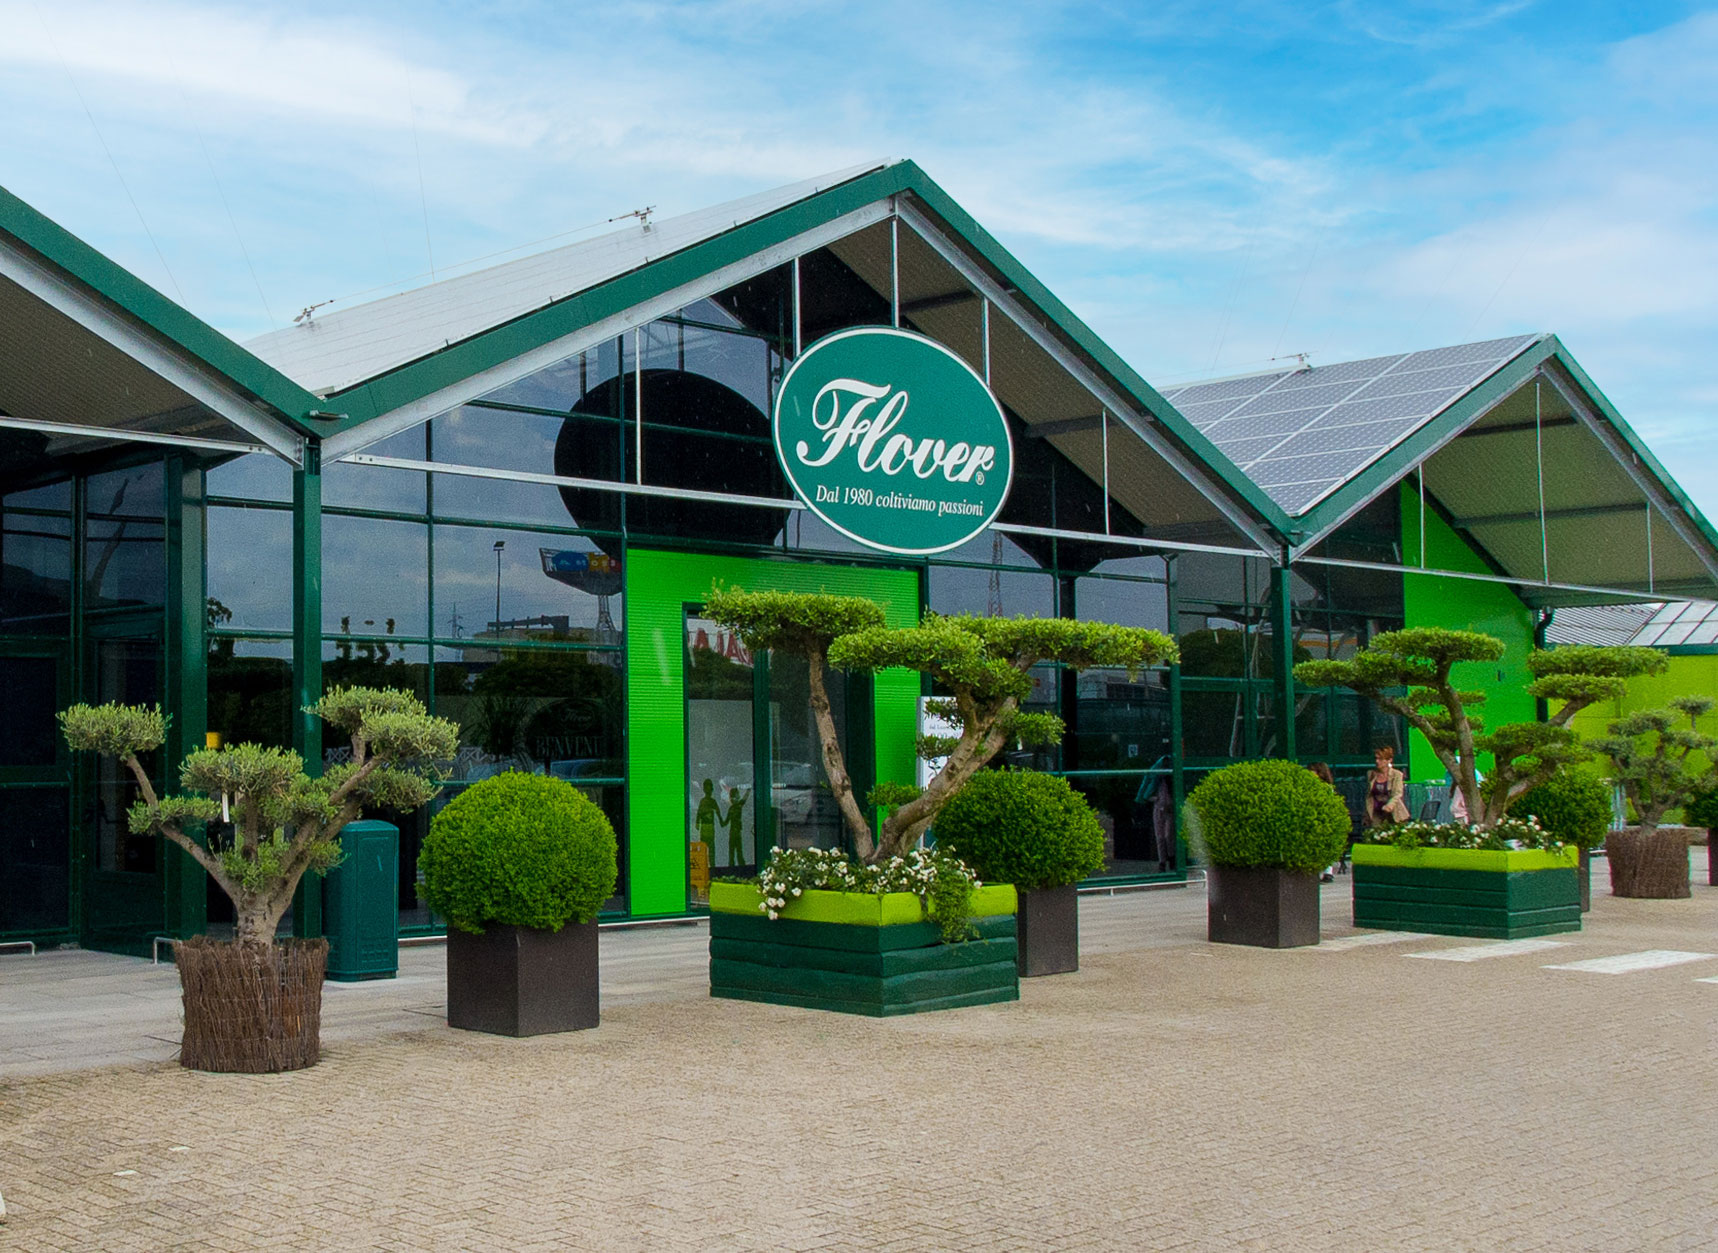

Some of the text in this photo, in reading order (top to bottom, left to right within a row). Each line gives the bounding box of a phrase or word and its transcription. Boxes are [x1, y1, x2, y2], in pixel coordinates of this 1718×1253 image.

[796, 378, 995, 482] Flover
[815, 485, 983, 517] Dal 1980 coltiviamo passioni
